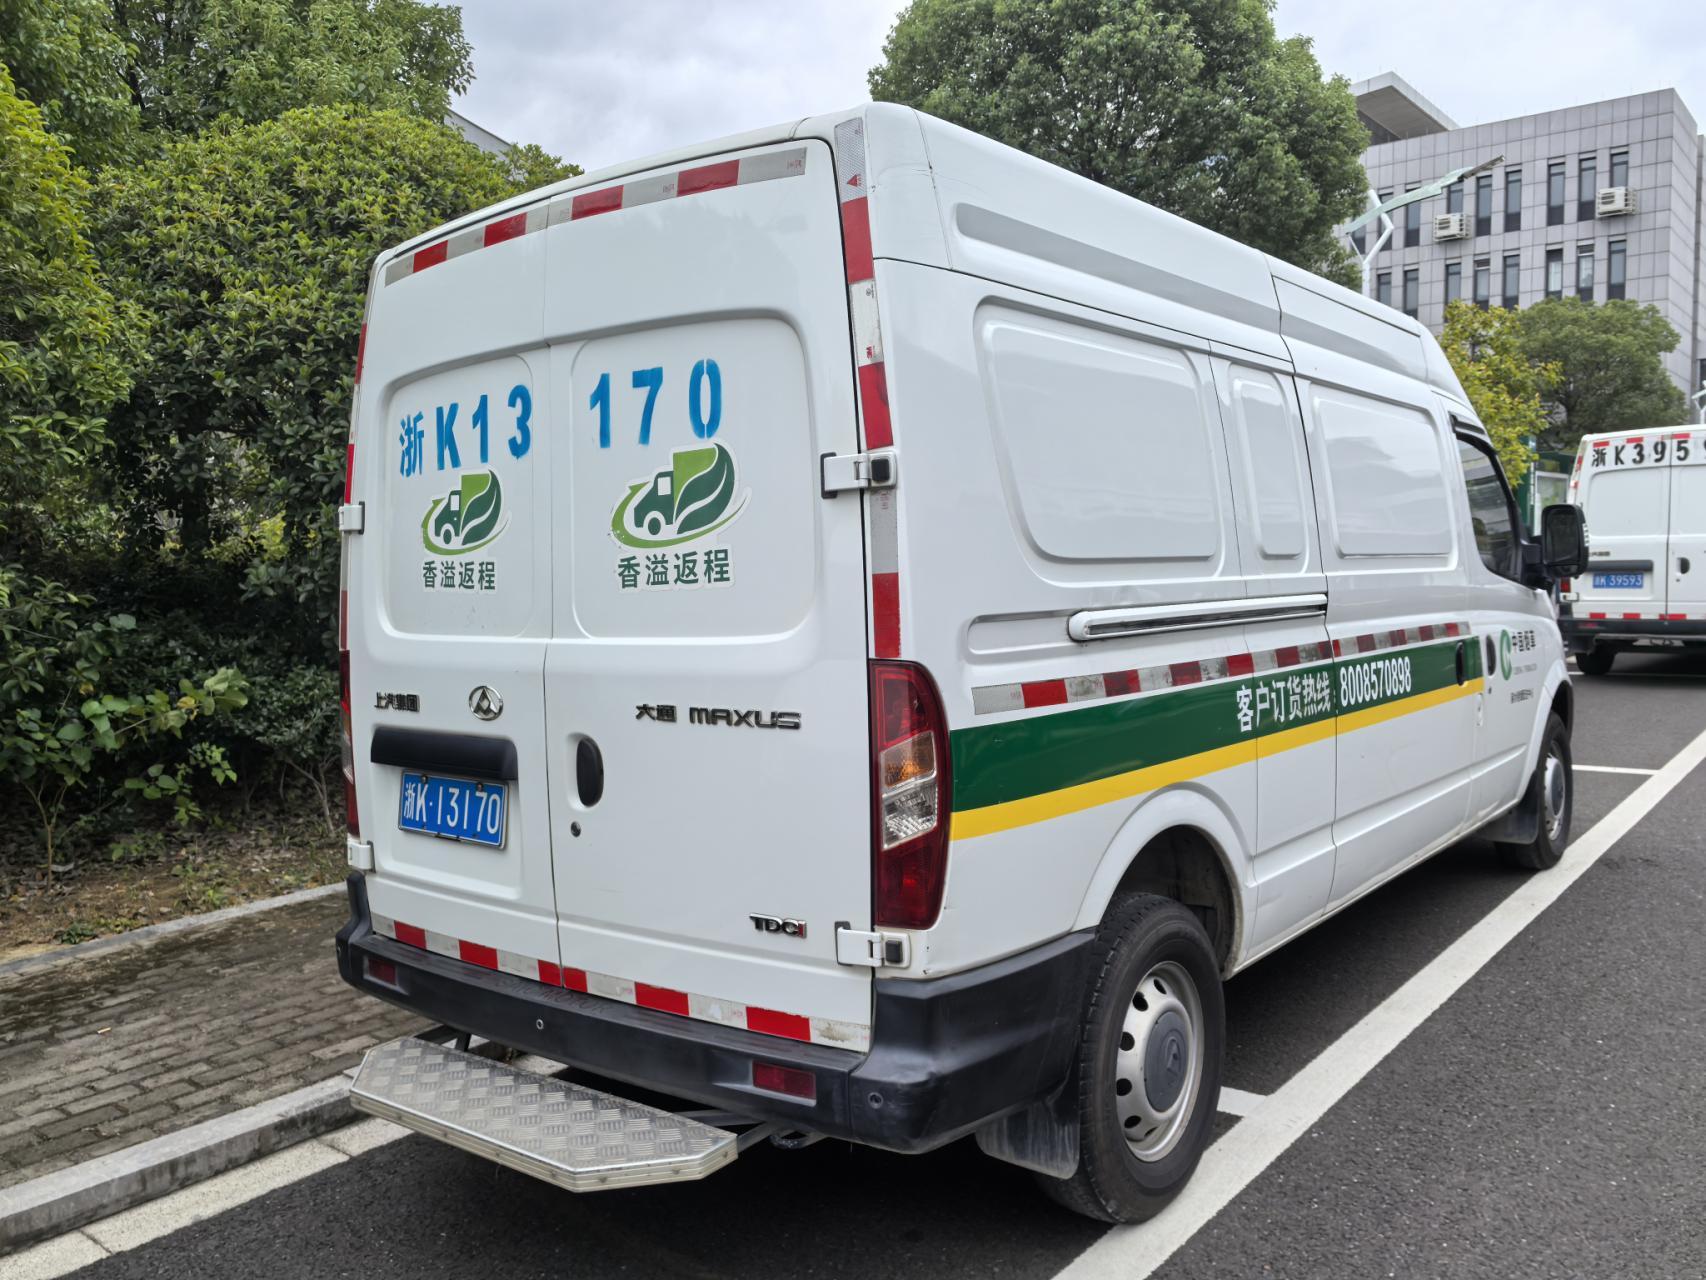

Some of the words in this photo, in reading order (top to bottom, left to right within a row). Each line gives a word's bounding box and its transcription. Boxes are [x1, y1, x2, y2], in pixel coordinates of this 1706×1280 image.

[1592, 439, 1706, 467] 浙K395
[422, 559, 496, 591] 香溢返程
[618, 548, 731, 590] 香溢返程
[1340, 656, 1412, 707] 8008570898
[635, 703, 677, 723] 大通
[689, 707, 801, 731] MAXUS
